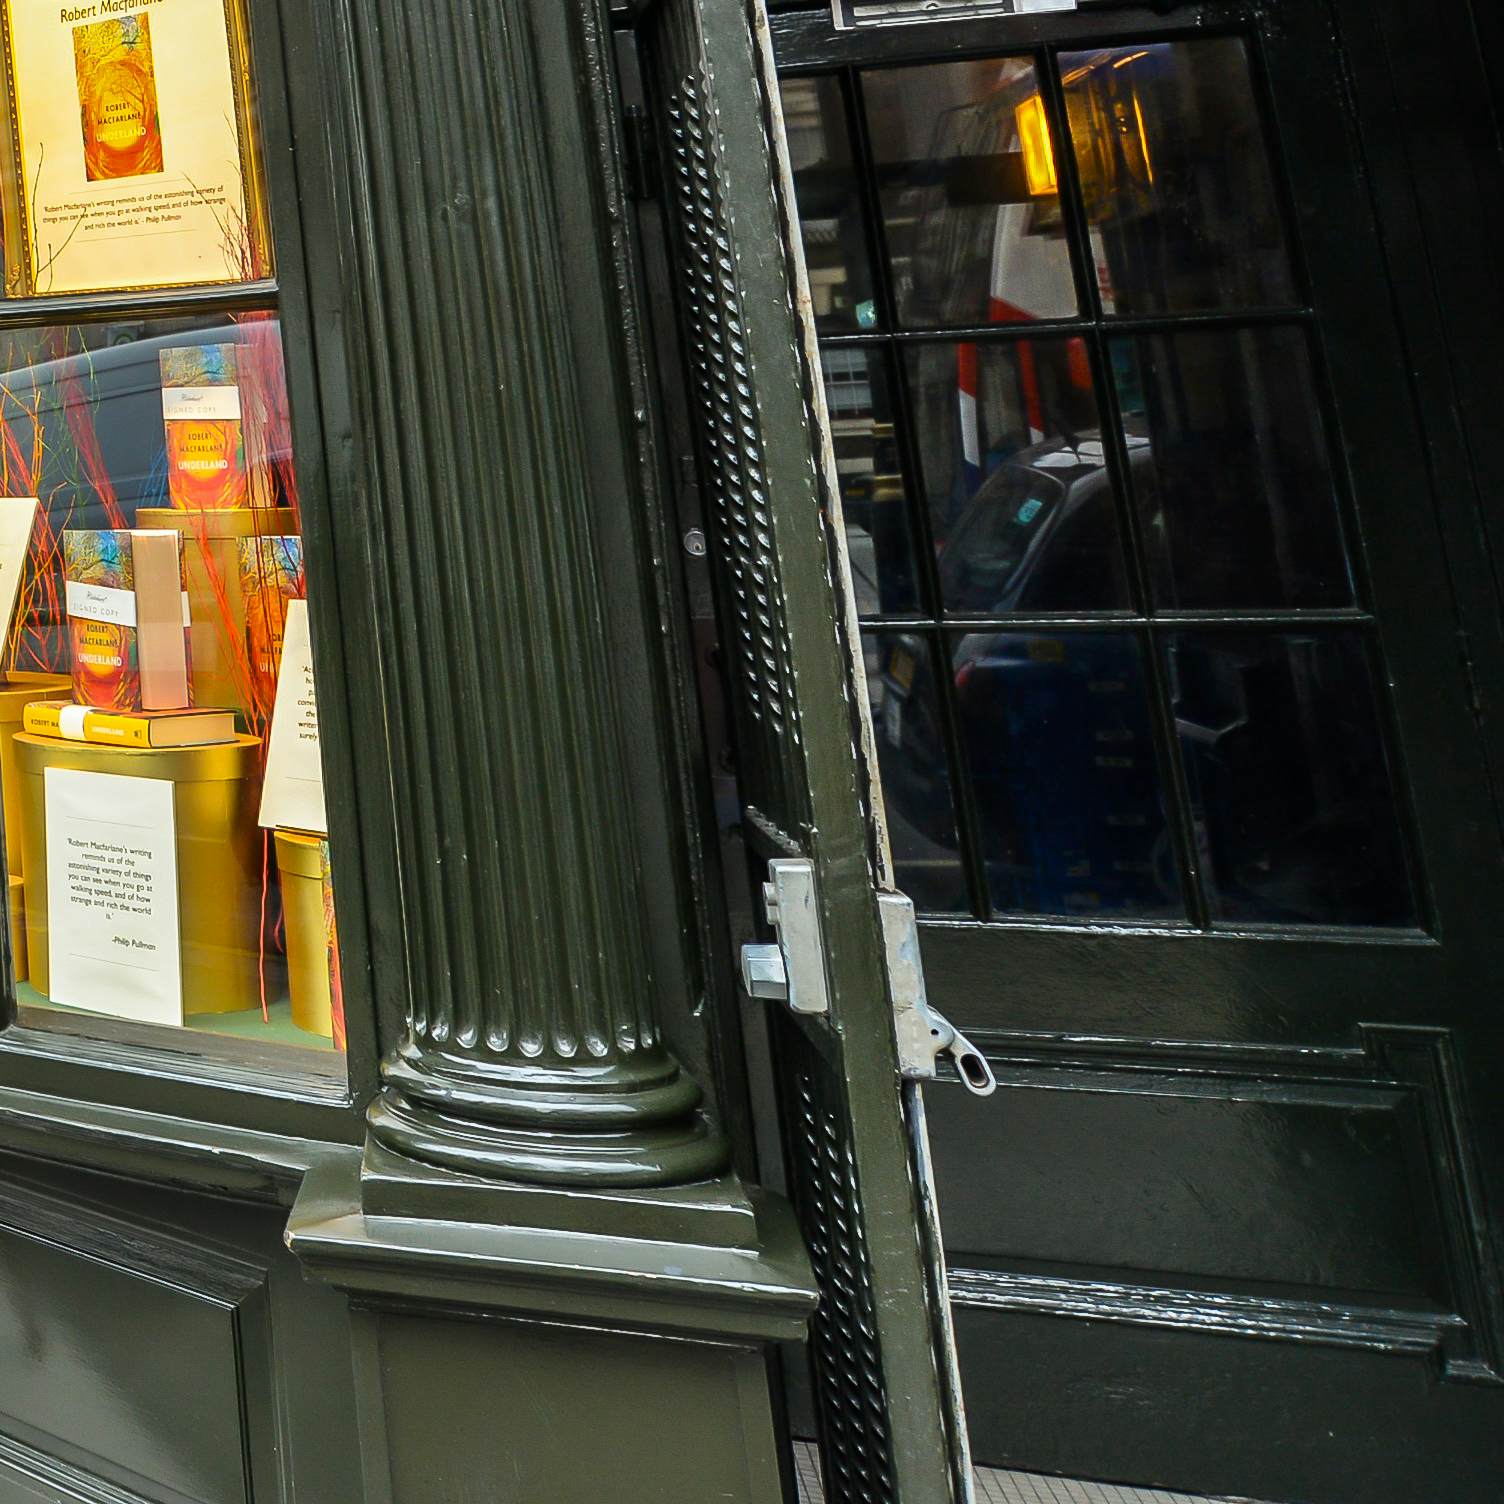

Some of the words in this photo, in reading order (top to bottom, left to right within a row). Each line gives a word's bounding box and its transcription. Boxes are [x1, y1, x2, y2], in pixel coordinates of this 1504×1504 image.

[60, 5, 97, 23] Robert
[105, 102, 131, 112] ROBERT
[97, 112, 142, 125] MACFARLANE
[96, 127, 147, 142] UNDERLAND
[188, 432, 212, 440] ROBERT
[178, 459, 228, 470] UNDERLAND
[86, 623, 109, 634] ROBERT
[78, 653, 122, 667] UNDERLAND
[30, 718, 50, 727] ROBERT
[82, 853, 105, 862] reminds
[125, 858, 135, 866] the
[130, 849, 152, 859] writing
[68, 862, 100, 874] astonishing
[102, 867, 122, 877] variety
[124, 869, 131, 877] of
[133, 872, 152, 882] things
[104, 878, 120, 887] when
[136, 884, 144, 892] go
[71, 884, 92, 895] walking
[136, 894, 150, 903] how
[71, 896, 91, 906] strange
[94, 899, 104, 907] and
[119, 903, 130, 911] the
[132, 906, 151, 915] world
[132, 938, 156, 950] Pullman
